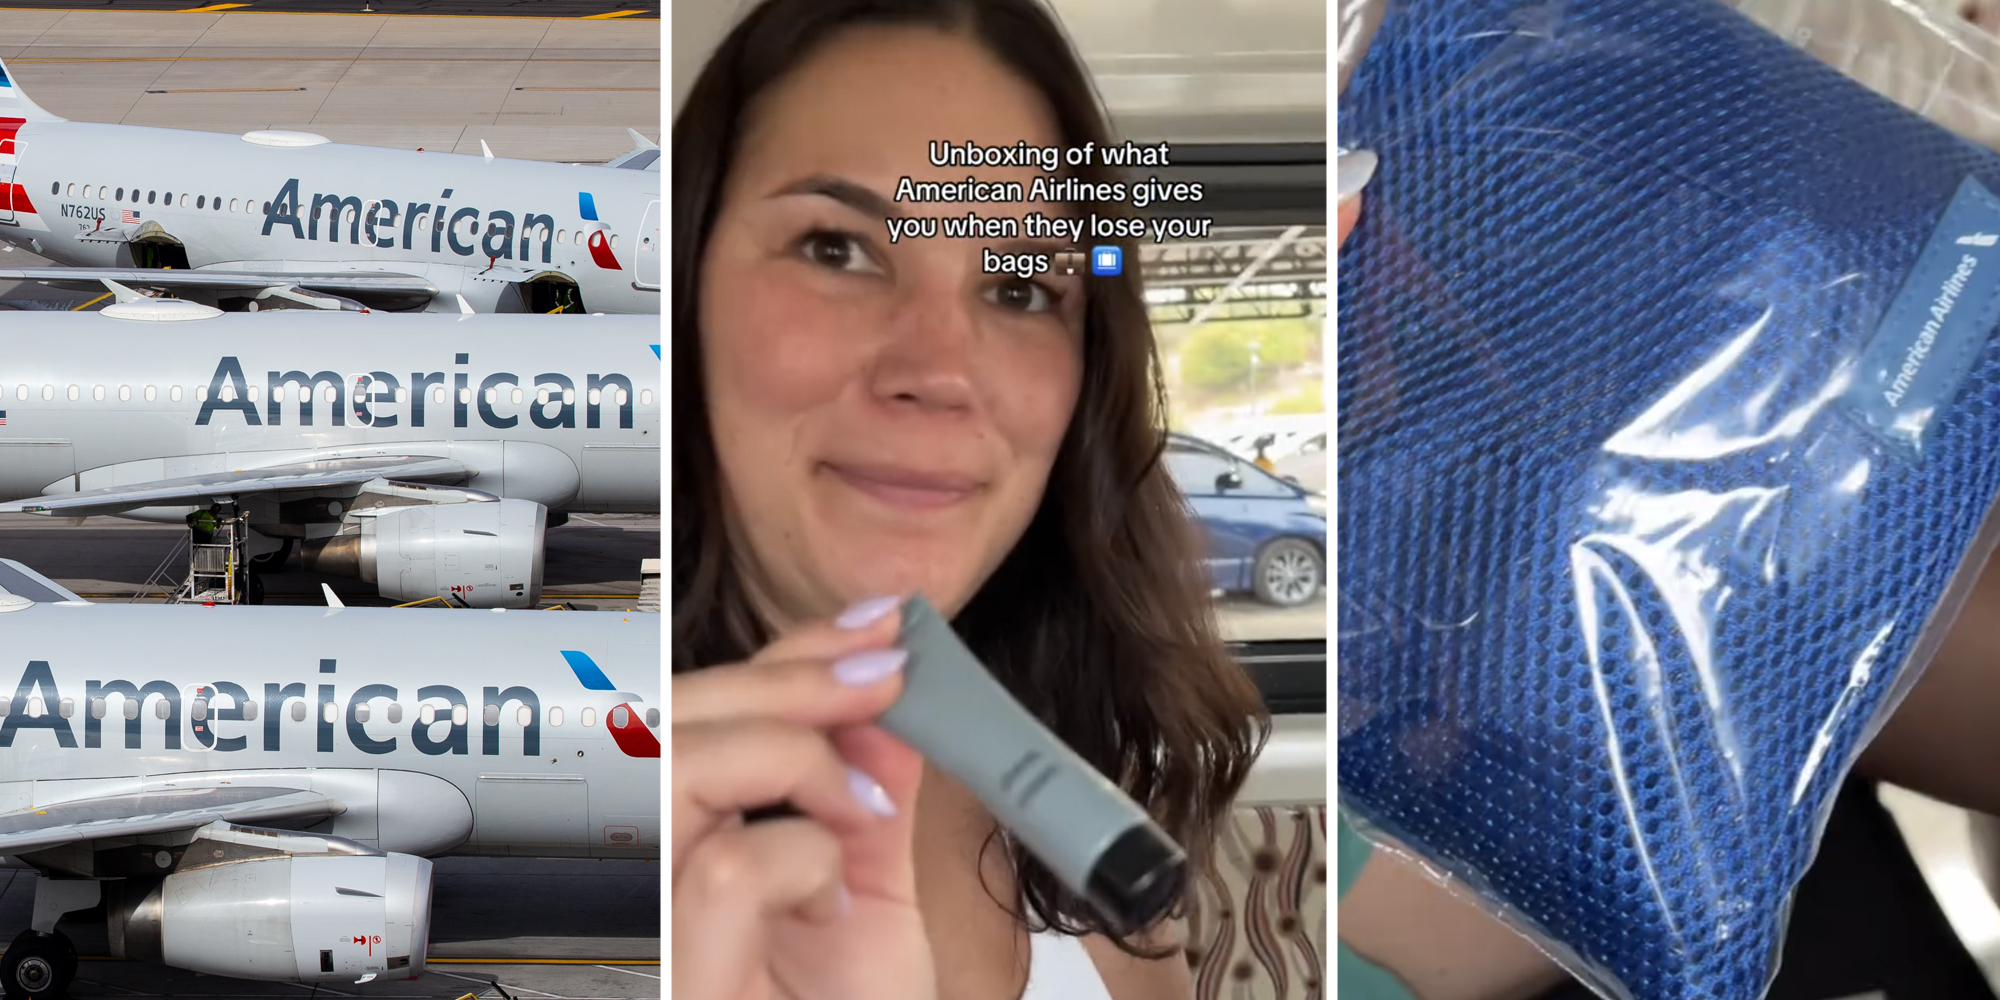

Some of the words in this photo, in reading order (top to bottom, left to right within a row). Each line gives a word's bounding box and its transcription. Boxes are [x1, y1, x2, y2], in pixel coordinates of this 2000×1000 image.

[61, 204, 106, 221] N762US
[261, 178, 555, 263] American
[1883, 319, 1942, 408] American
[1929, 253, 1978, 323] Airlines
[194, 353, 634, 430] American
[0, 658, 540, 757] American
